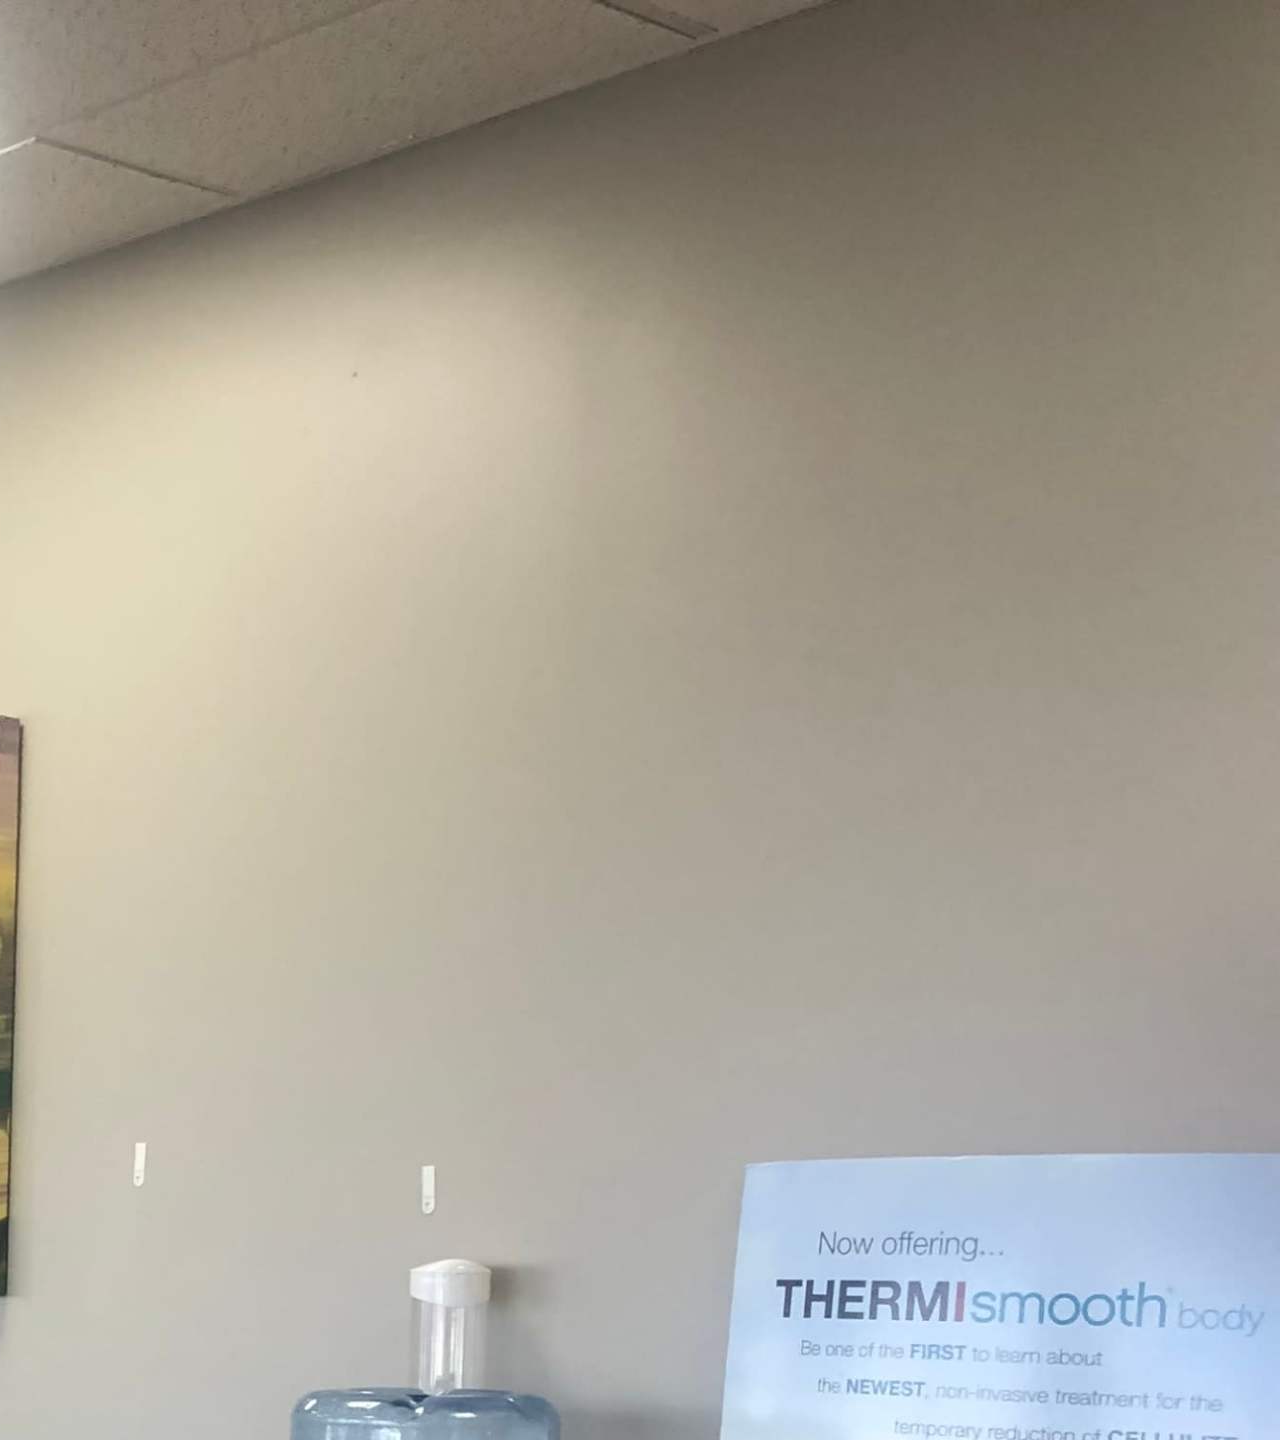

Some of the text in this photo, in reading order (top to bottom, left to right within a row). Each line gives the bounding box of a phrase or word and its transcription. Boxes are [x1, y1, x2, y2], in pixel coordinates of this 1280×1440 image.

[818, 1231, 1004, 1262] Now offering...
[1178, 1303, 1265, 1337] body
[800, 1340, 1103, 1366] Be one of the FIRST to learn about
[818, 1378, 1224, 1412] the NEWEST, non-invasive treatment for the
